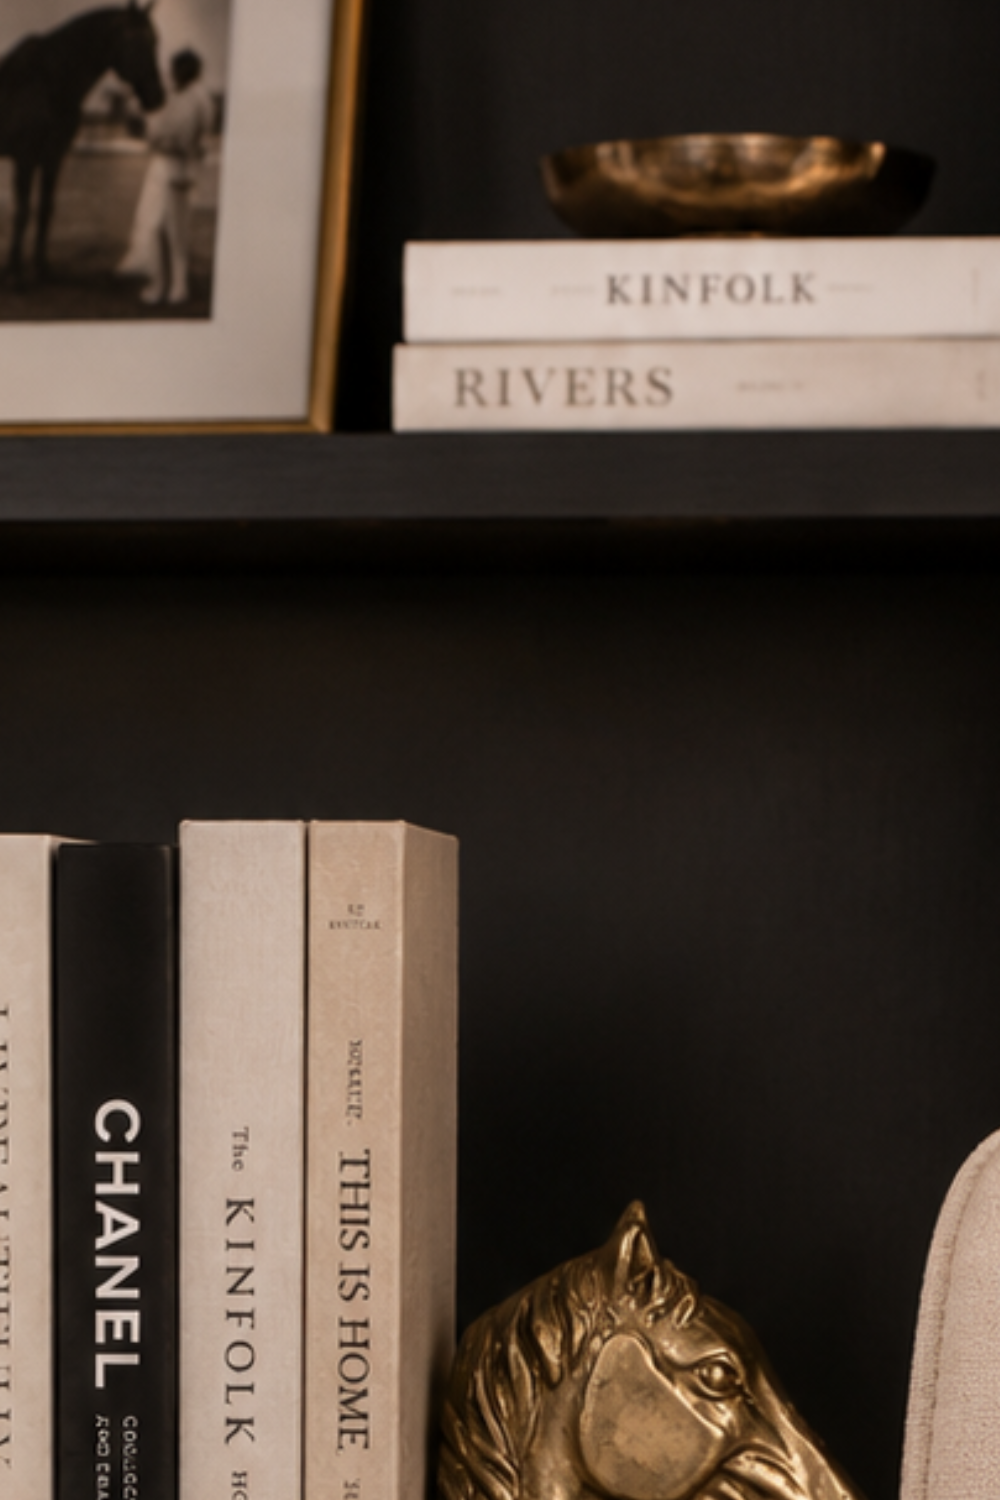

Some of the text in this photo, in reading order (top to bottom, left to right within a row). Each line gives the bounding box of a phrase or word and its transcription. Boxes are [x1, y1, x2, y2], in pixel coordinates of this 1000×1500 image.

[606, 272, 816, 306] KINFOLK
[454, 366, 674, 408] RIVERS
[231, 1126, 250, 1172] The
[338, 1147, 372, 1252] THIS
[93, 1098, 142, 1390] CHANEL
[337, 1261, 371, 1302] IS
[224, 1197, 257, 1446] KINFOLK
[336, 1316, 371, 1450] HOME
